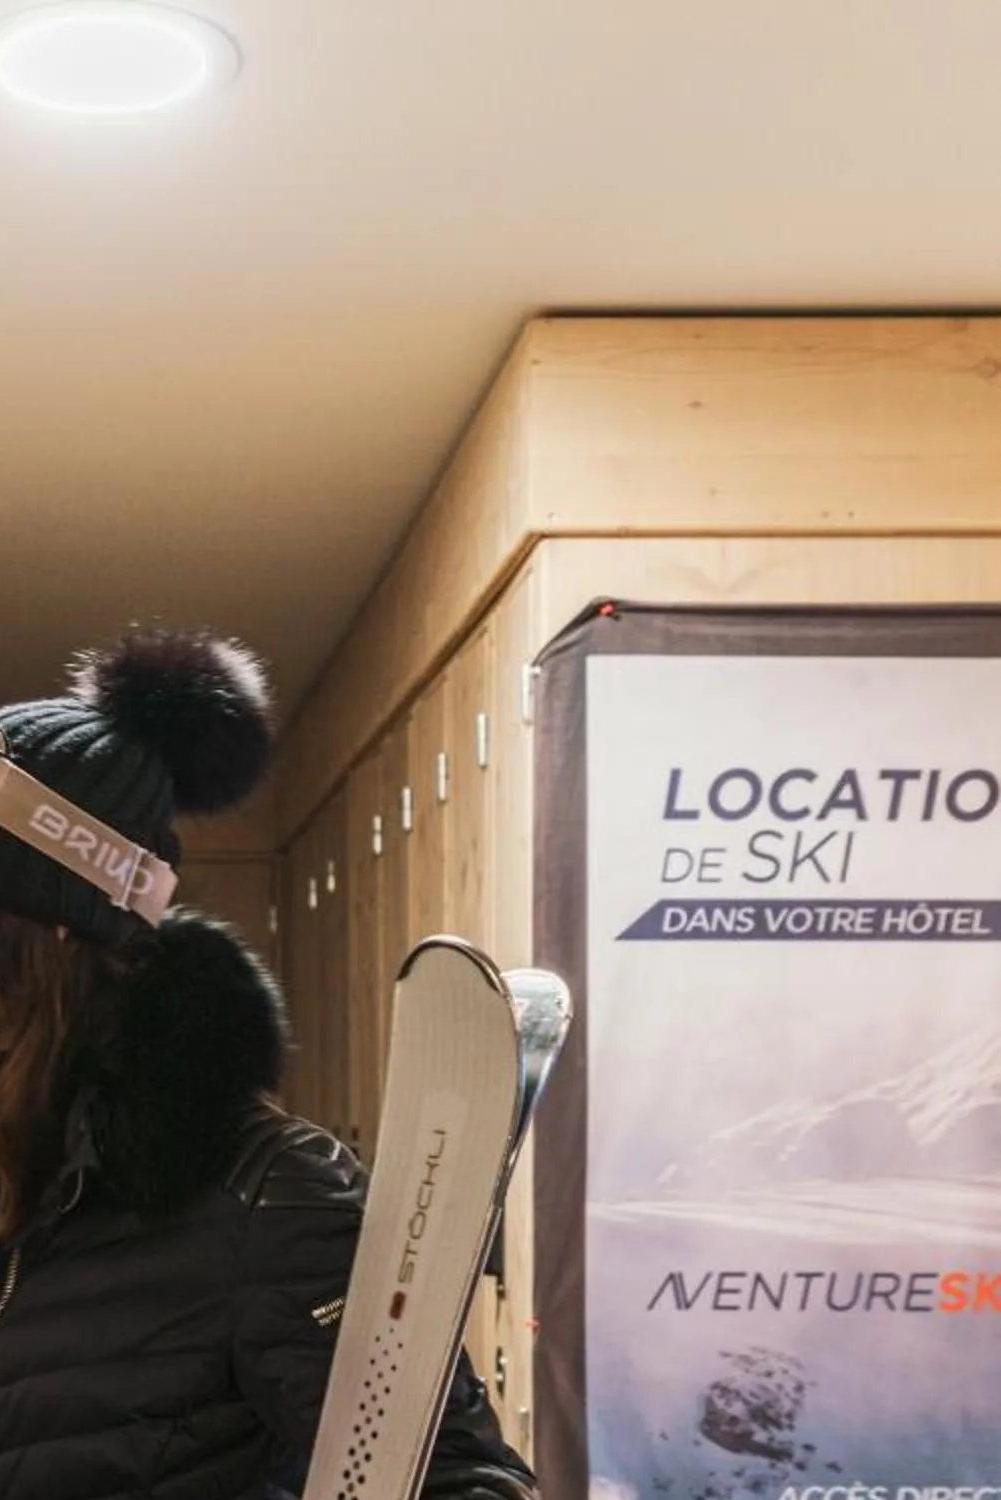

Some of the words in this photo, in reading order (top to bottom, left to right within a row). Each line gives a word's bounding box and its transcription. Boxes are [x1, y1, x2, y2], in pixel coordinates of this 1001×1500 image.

[662, 768, 1001, 821] LOCATIO
[661, 848, 727, 884] DE
[741, 829, 855, 884] SKI
[662, 907, 755, 934] DANS
[764, 907, 874, 934] VOTRE
[881, 902, 992, 934] HÔTEL
